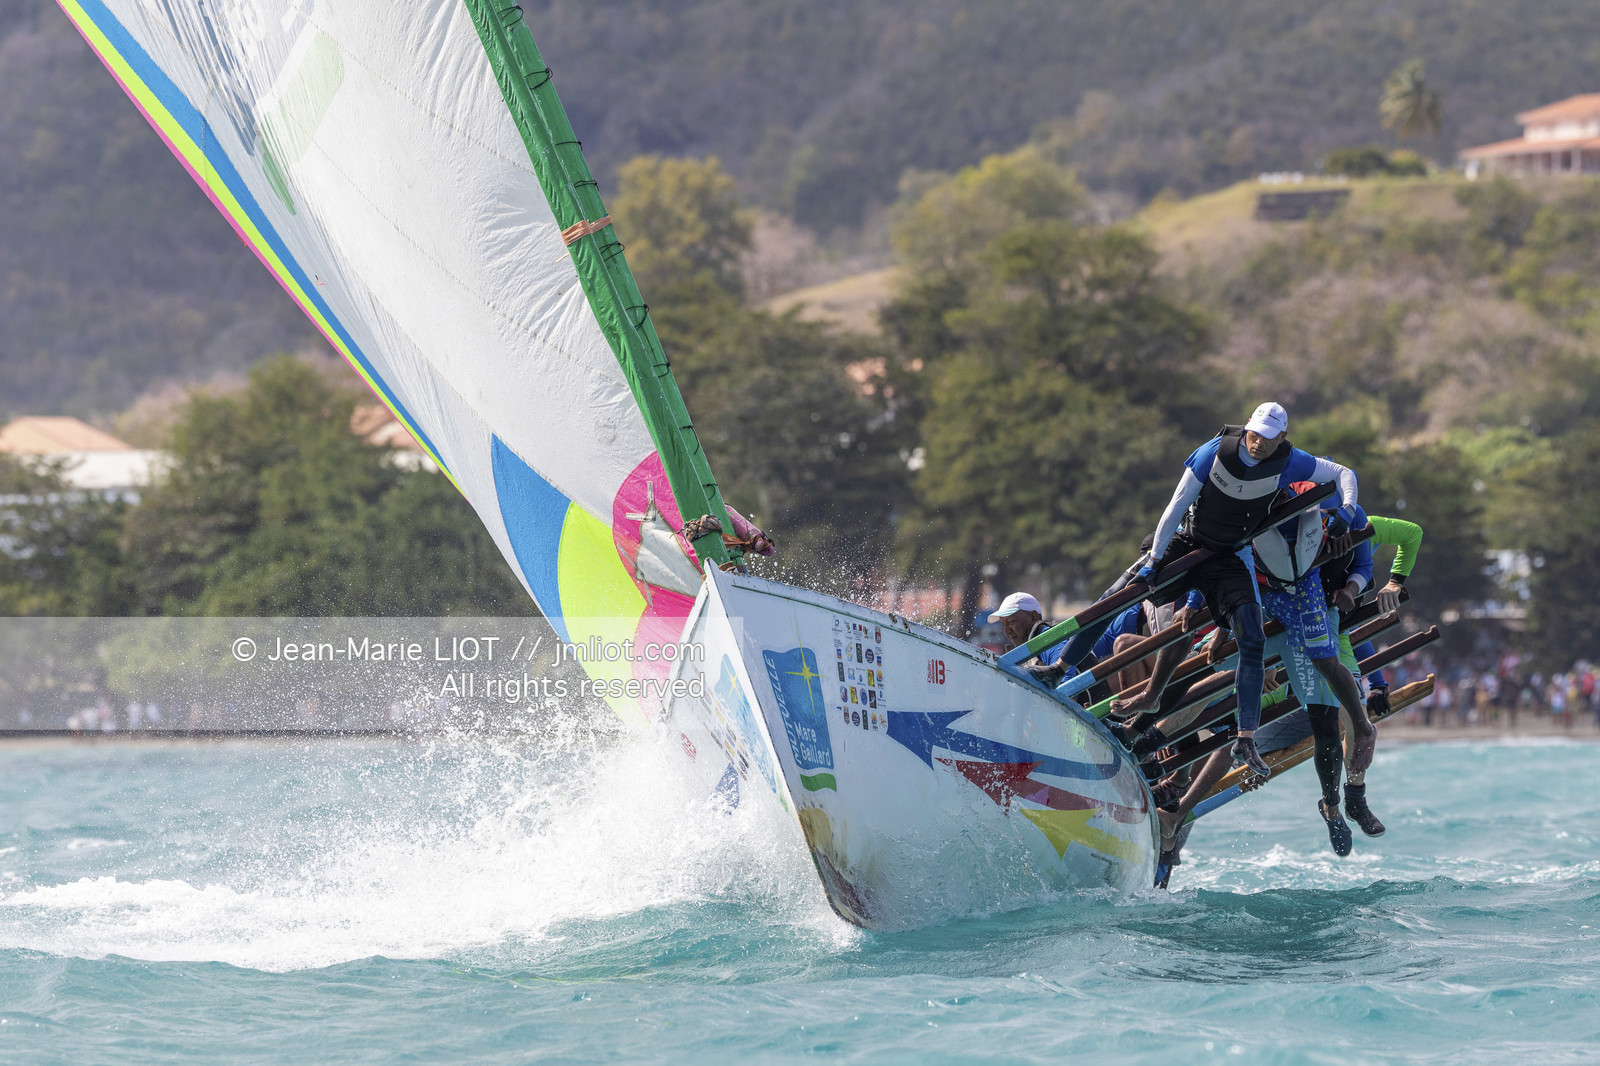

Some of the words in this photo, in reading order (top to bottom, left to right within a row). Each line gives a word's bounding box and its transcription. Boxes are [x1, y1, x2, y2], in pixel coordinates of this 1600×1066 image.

[1304, 623, 1326, 632] MMG
[1293, 647, 1307, 690] MUTUE
[1306, 668, 1315, 697] Mare
[764, 653, 802, 766] MUTUELLE
[793, 721, 817, 742] Mare
[800, 741, 831, 767] Gaillard
